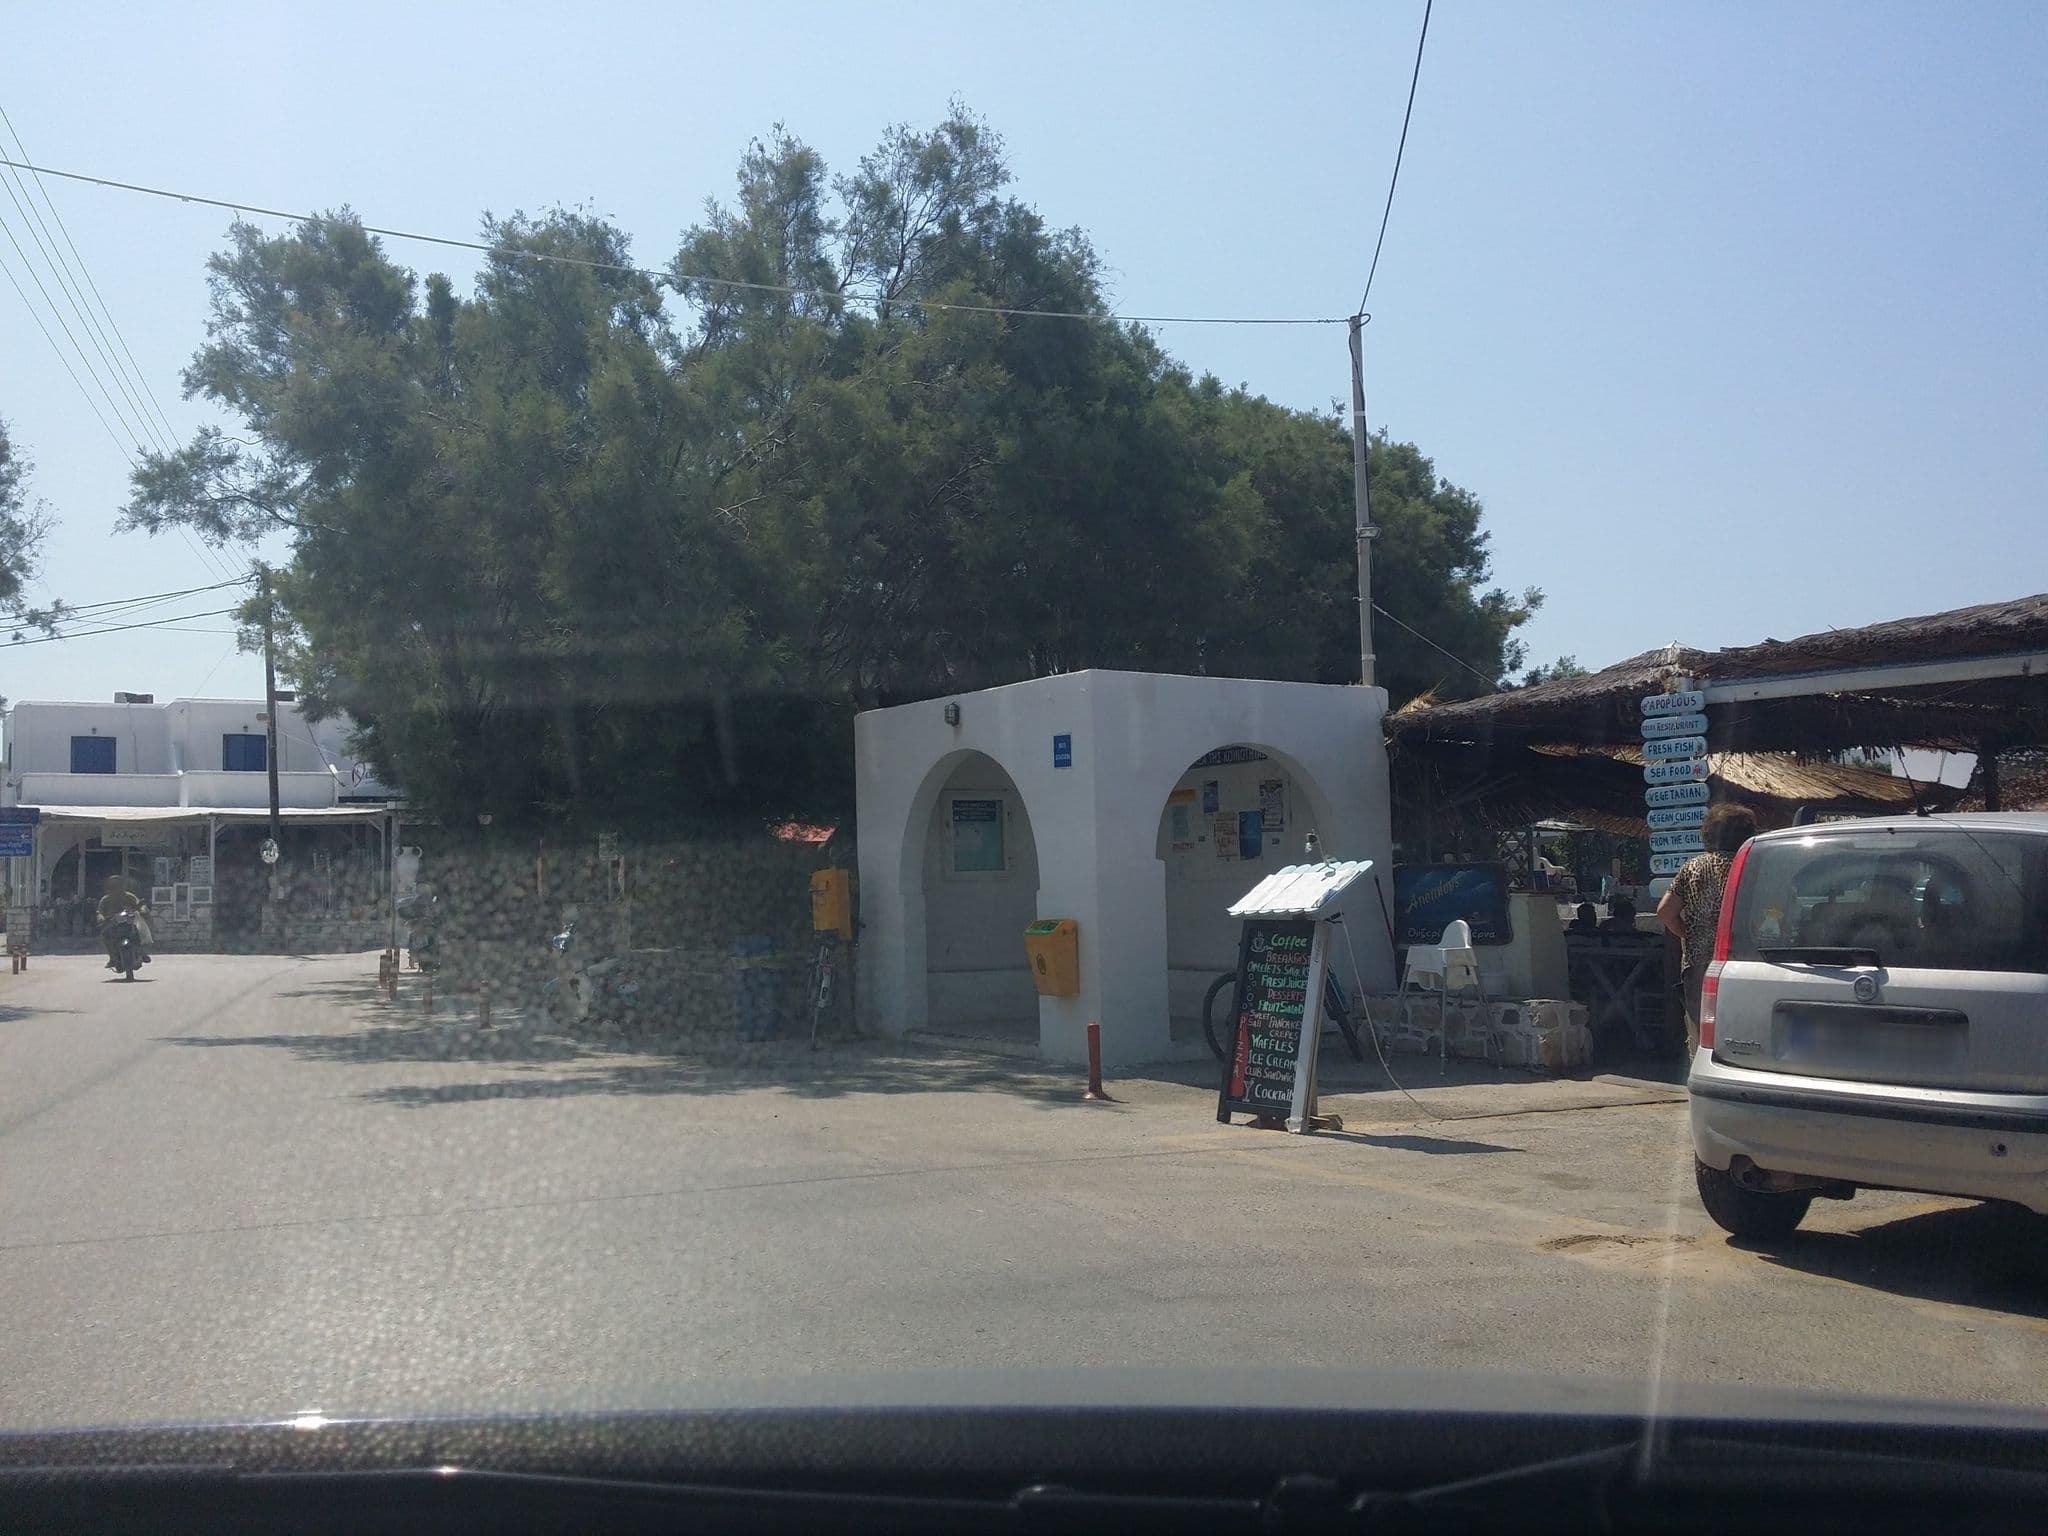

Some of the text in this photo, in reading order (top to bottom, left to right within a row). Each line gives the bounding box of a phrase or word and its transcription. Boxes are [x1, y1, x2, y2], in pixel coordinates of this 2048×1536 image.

[1656, 721, 1699, 732] RESTAURANT
[1648, 741, 1694, 755] FRESH FISH
[1650, 765, 1691, 778] SEA FOOD
[1648, 786, 1701, 802] VEGETARIAN
[1649, 810, 1705, 823] AEGEAN CUISINE
[1650, 833, 1703, 847] FROM THE GRIL
[1663, 857, 1692, 869] PIZZ
[1271, 933, 1308, 950] Coffee
[1261, 974, 1286, 988] FRESH
[1267, 988, 1305, 1002] DESSERTS
[1258, 999, 1280, 1013] FRUIT
[1233, 1016, 1247, 1078] PIZZA
[1252, 1034, 1294, 1054] WAFFLES
[1248, 1050, 1298, 1071] ICE CREAM
[1245, 1065, 1262, 1079] CLUB
